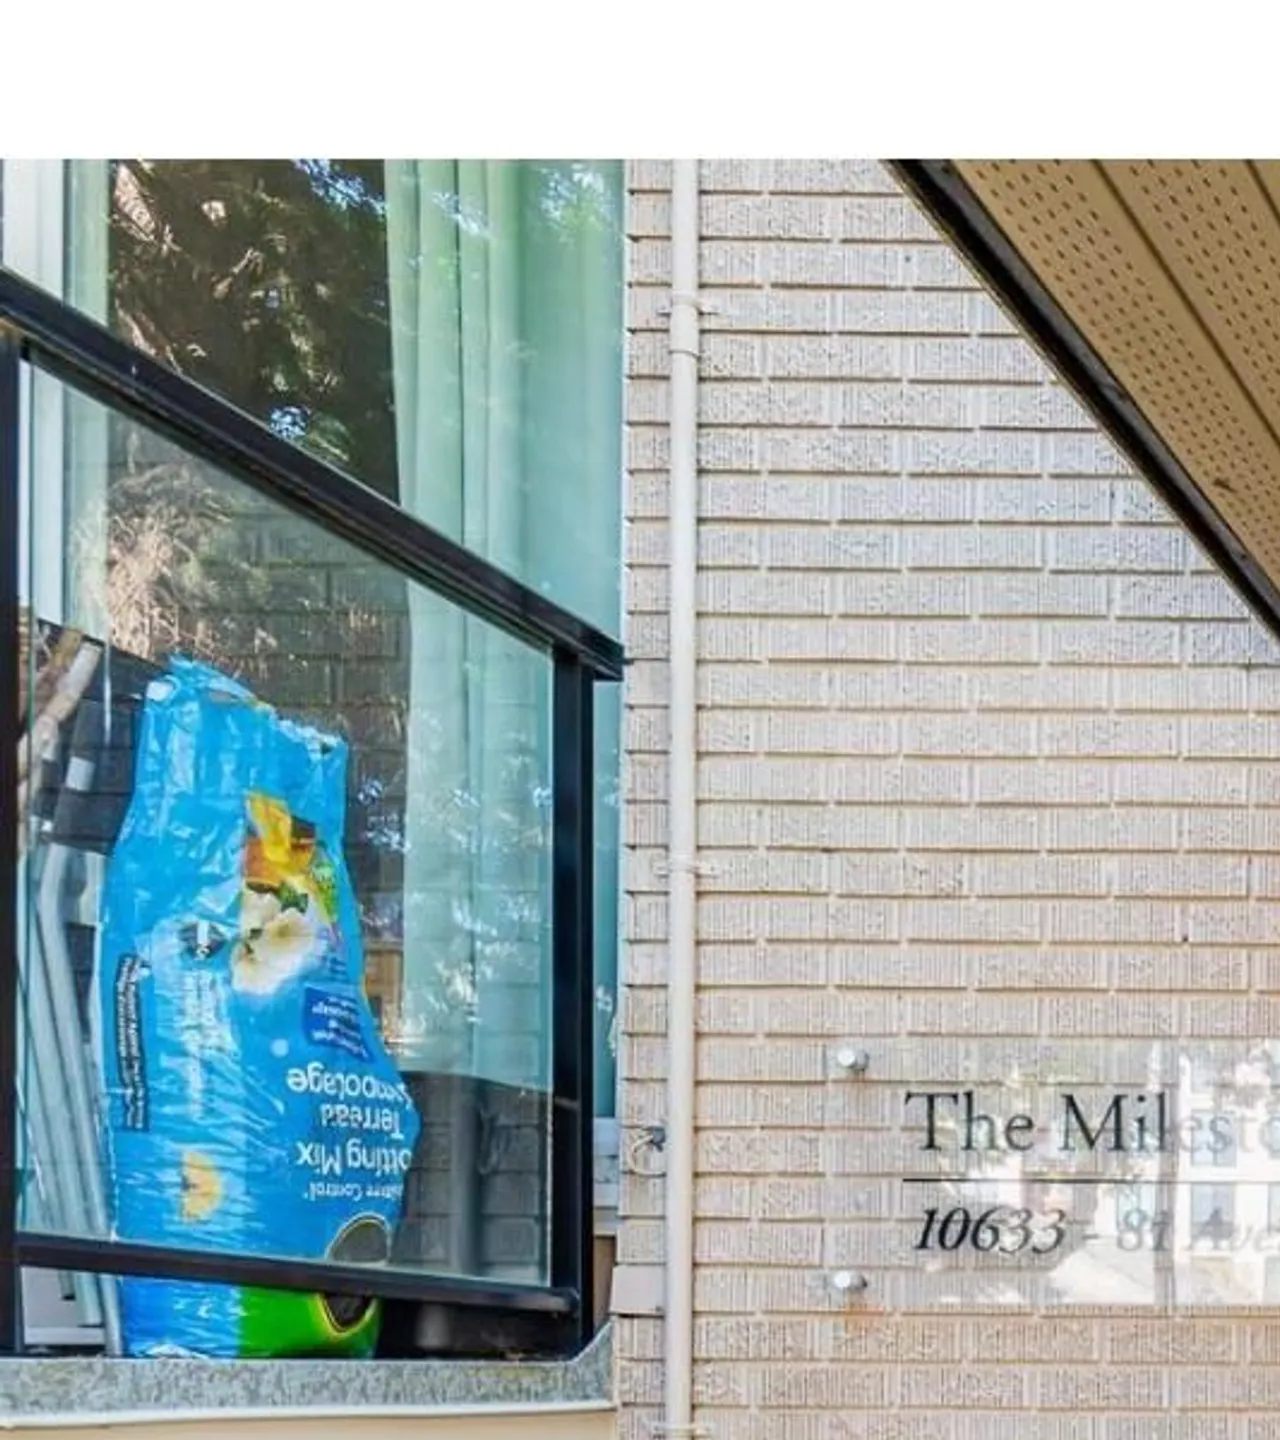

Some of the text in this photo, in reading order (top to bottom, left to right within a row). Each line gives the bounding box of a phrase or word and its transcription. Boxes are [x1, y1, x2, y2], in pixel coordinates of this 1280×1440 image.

[903, 1090, 1035, 1152] The
[295, 1138, 412, 1178] otting Mix
[914, 1206, 1066, 1254] 10633
[1115, 1207, 1178, 1252] 81
